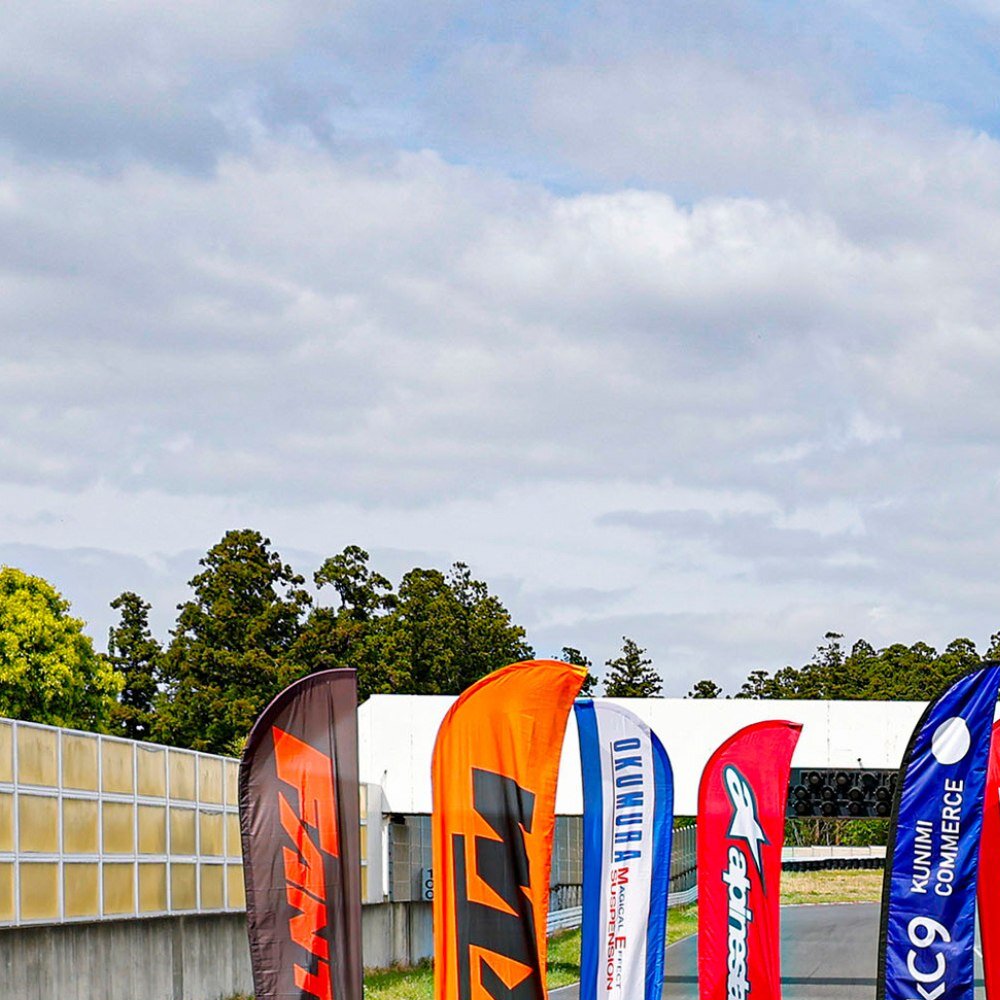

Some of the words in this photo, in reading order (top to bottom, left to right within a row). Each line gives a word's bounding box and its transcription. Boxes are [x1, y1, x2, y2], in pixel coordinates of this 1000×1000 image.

[613, 738, 644, 862] OKUMURA
[910, 820, 933, 893] KUNIMI
[934, 778, 963, 897] COMMERCE
[606, 869, 619, 990] SUSPENSION
